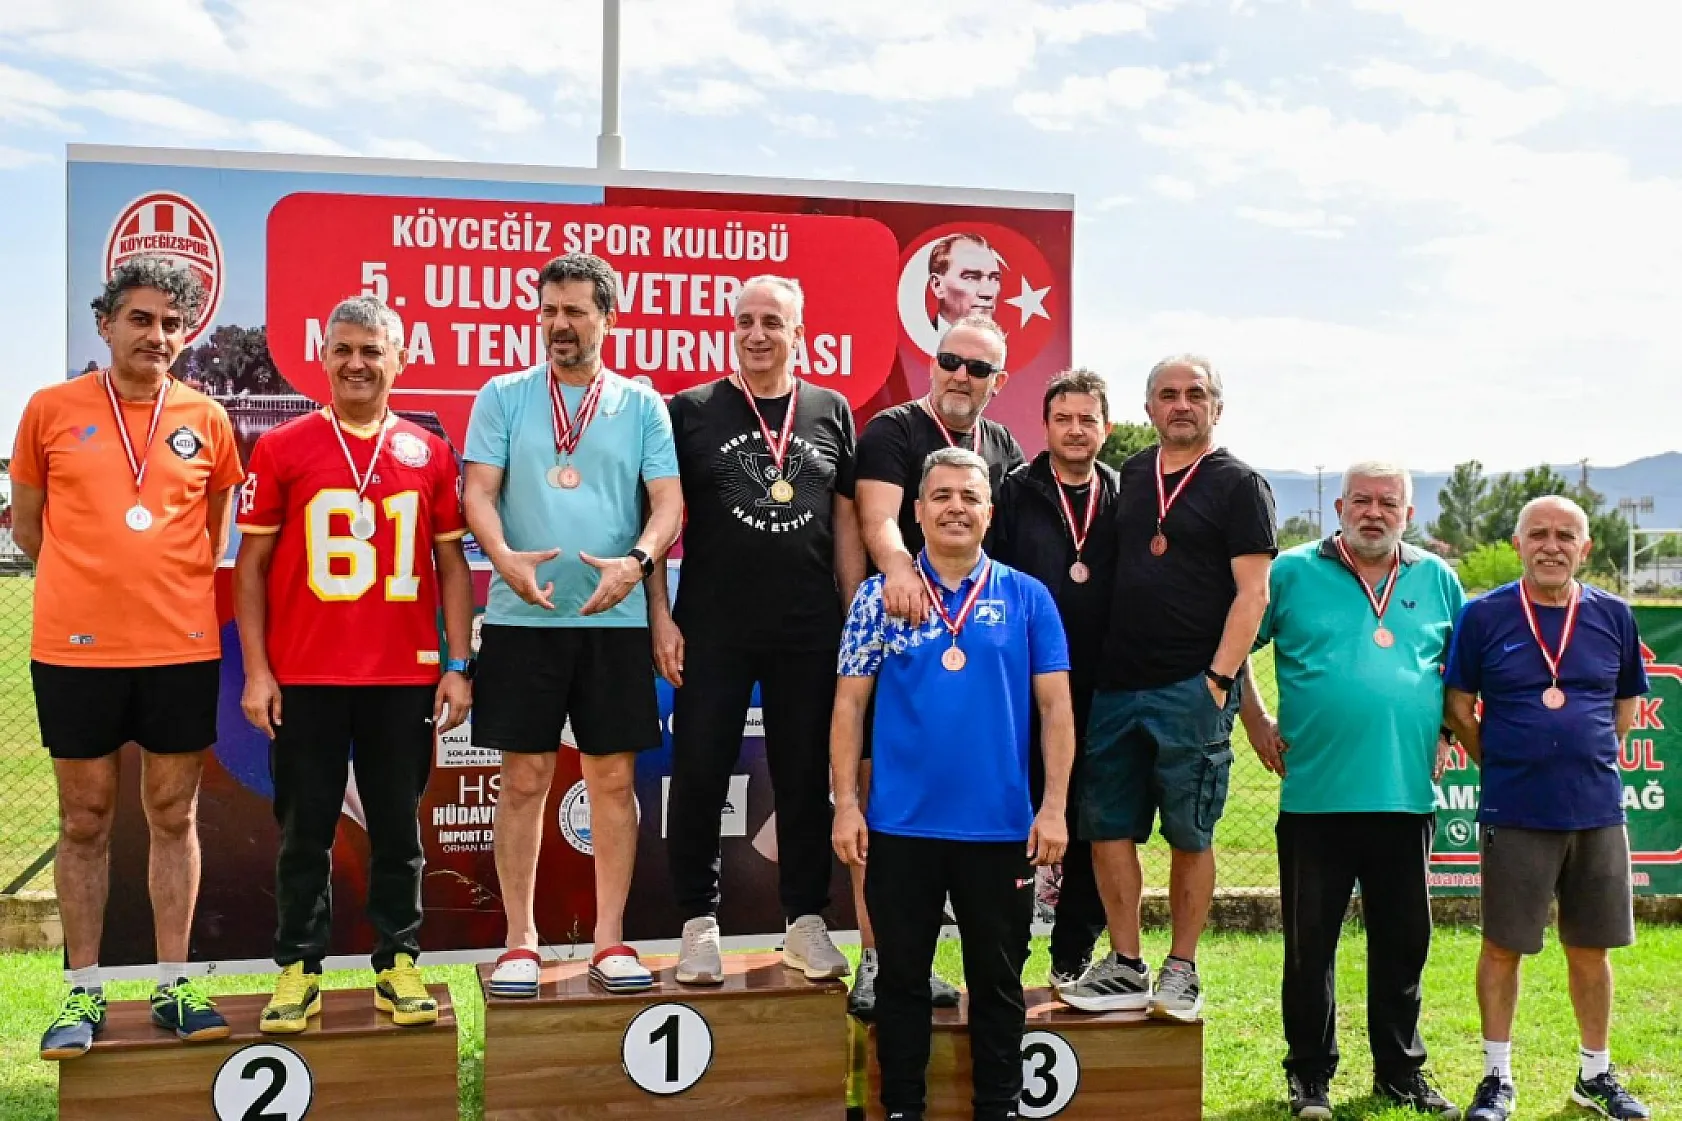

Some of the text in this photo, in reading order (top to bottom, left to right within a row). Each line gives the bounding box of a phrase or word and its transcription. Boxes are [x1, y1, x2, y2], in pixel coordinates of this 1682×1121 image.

[393, 208, 789, 262] KÖYCEĞİZ SPOR KULÜBÜ
[361, 262, 737, 317] 5. ULUS VETER
[304, 315, 853, 376] MA TENİ TURNASI
[305, 488, 421, 602] 61
[649, 1014, 682, 1083] 1
[1020, 1042, 1058, 1109] 3
[240, 1056, 288, 1121] 2
